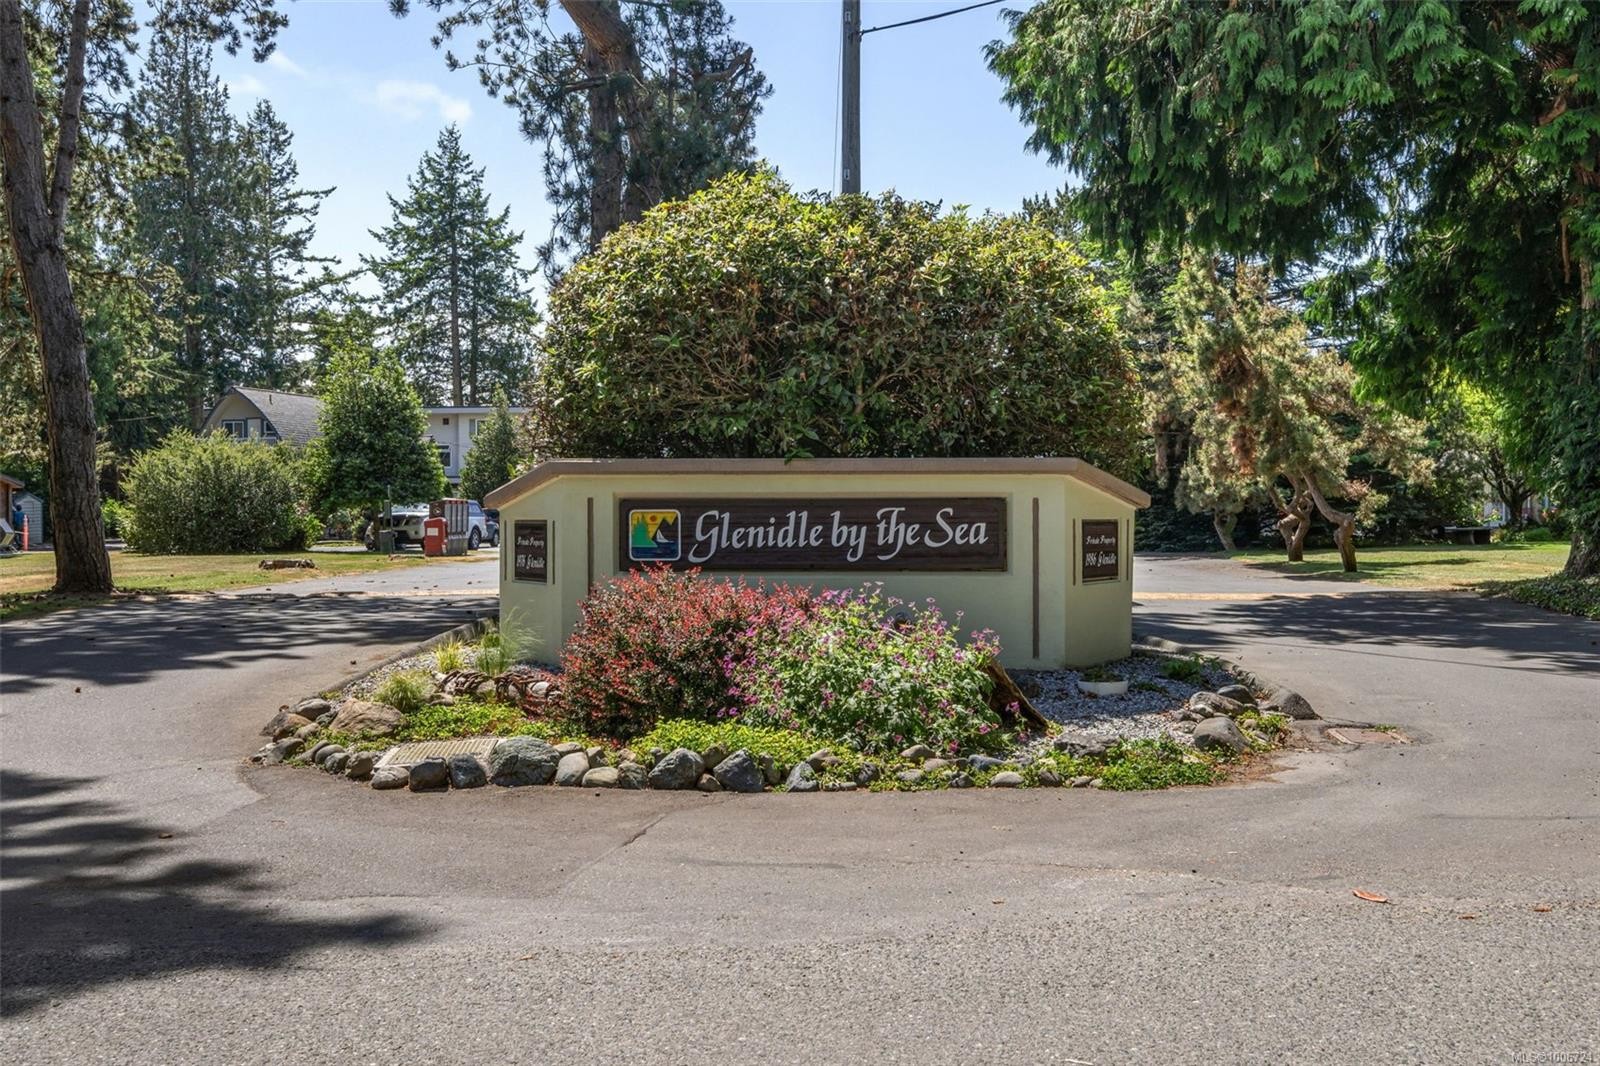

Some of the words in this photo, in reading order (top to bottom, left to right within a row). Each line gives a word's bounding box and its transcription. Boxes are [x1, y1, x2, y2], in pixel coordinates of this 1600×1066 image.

[688, 510, 823, 563] Glenidle
[831, 510, 867, 562] by
[924, 507, 989, 548] Sea
